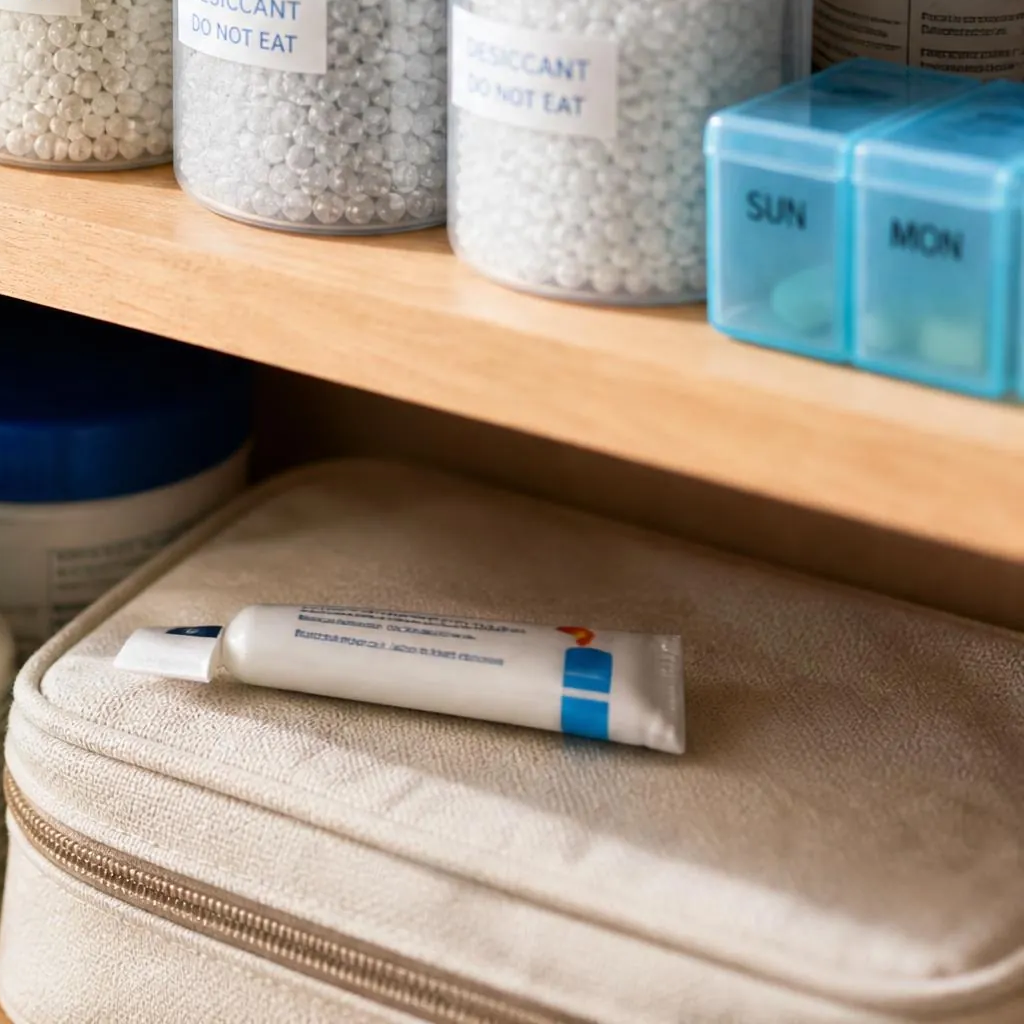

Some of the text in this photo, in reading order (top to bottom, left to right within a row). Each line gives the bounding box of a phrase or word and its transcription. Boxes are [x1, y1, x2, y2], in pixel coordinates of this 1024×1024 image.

[192, 12, 297, 53] DO NOT EAT
[542, 91, 586, 117] EAT
[746, 189, 808, 231] SUN
[890, 217, 965, 262] MON
